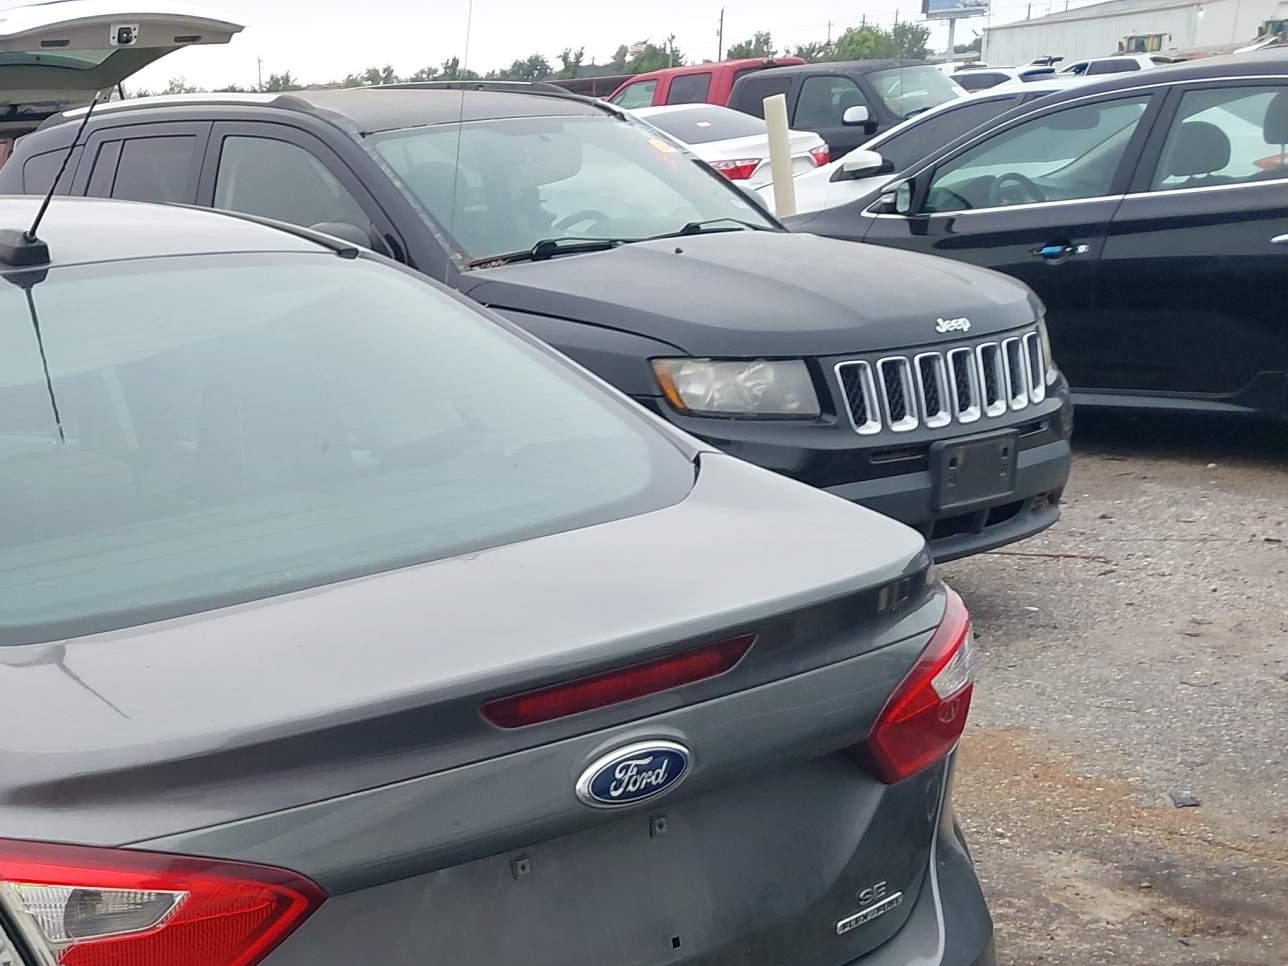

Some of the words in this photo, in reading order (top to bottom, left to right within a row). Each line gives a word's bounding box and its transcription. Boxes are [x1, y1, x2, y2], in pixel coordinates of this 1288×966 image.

[935, 317, 971, 333] Jeep
[609, 756, 669, 797] Ford
[858, 880, 888, 906] SE
